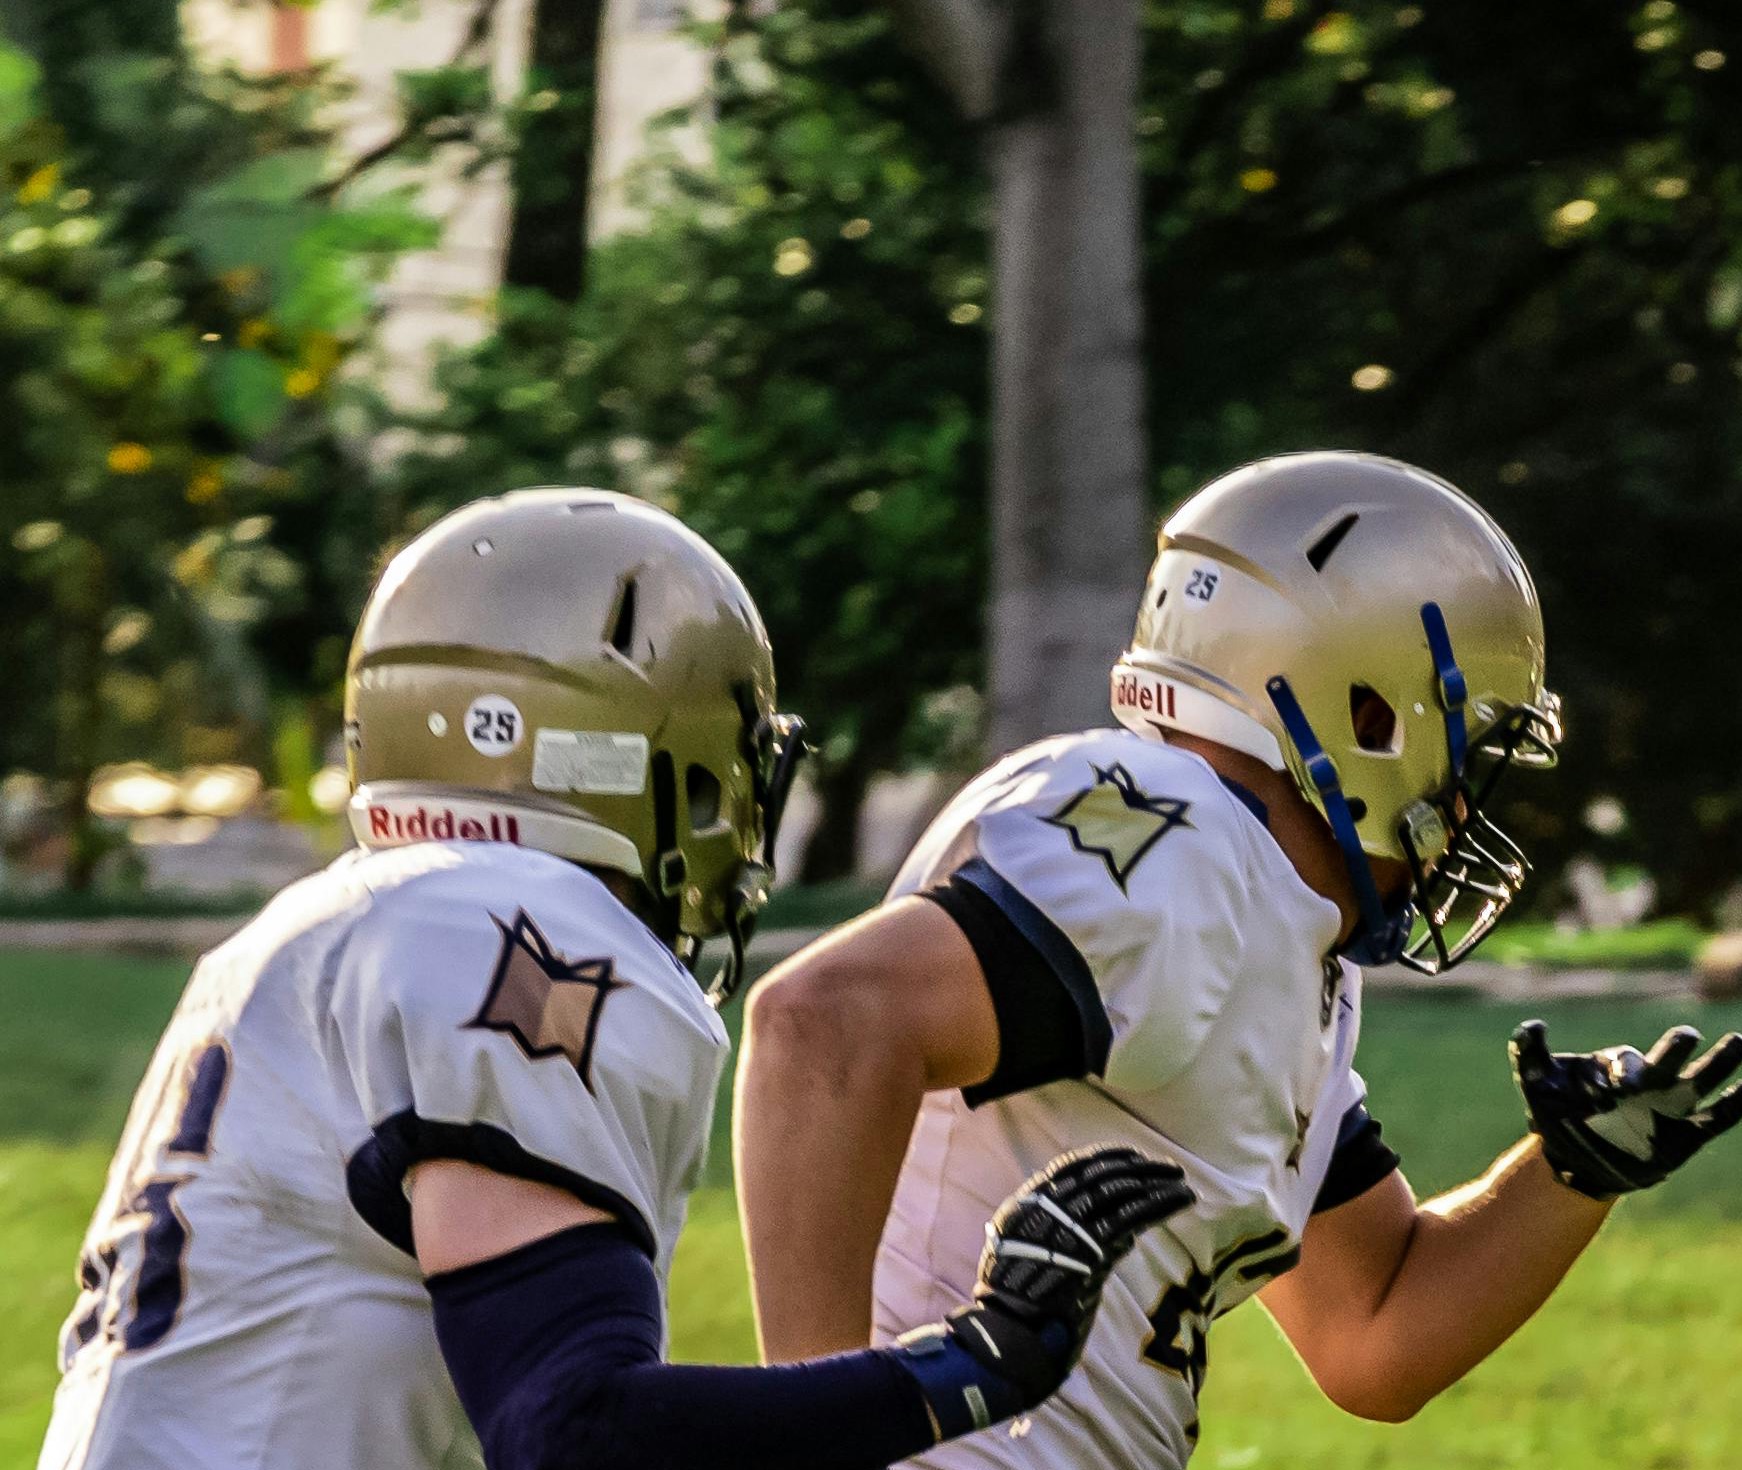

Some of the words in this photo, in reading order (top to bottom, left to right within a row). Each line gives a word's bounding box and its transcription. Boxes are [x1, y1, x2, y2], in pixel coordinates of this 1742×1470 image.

[1184, 568, 1219, 602] 25
[1116, 675, 1177, 719] ddell
[471, 708, 517, 745] 25
[369, 804, 520, 846] Riddell
